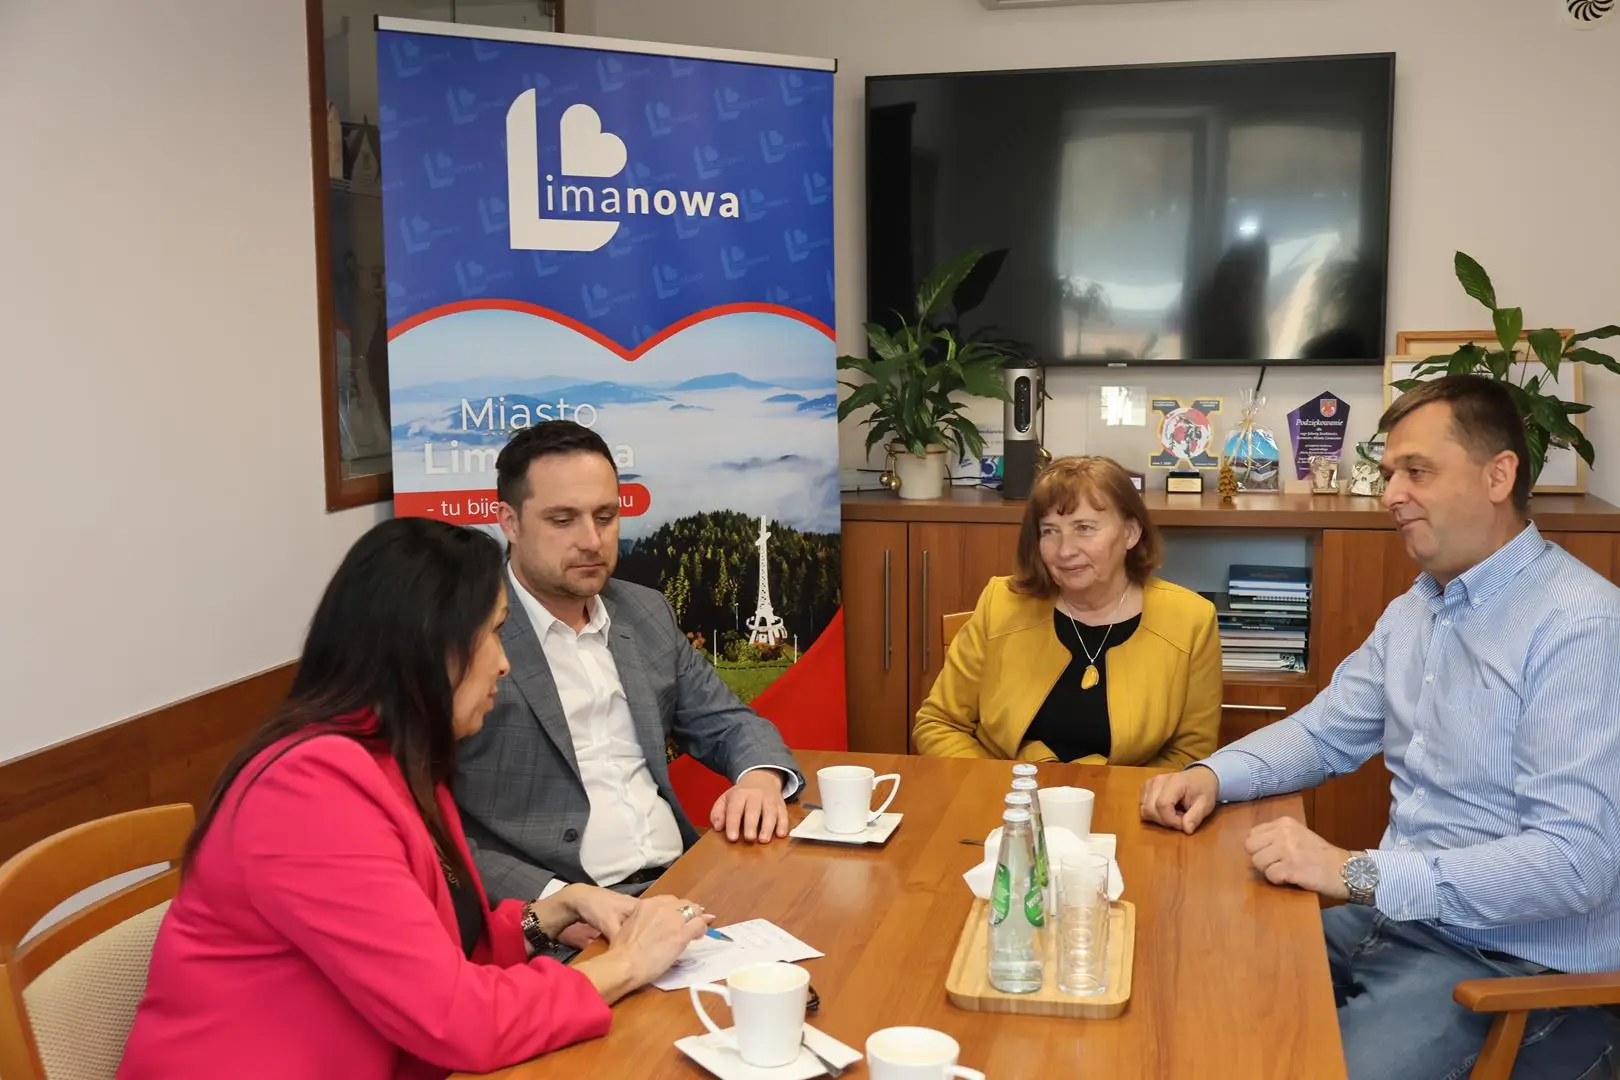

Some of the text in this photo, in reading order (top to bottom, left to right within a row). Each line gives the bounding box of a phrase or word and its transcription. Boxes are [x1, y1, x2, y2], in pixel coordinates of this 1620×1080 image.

[461, 396, 598, 431] Miasto
[424, 440, 634, 475] Lima
[441, 500, 460, 516] tu
[467, 497, 500, 518] bije
